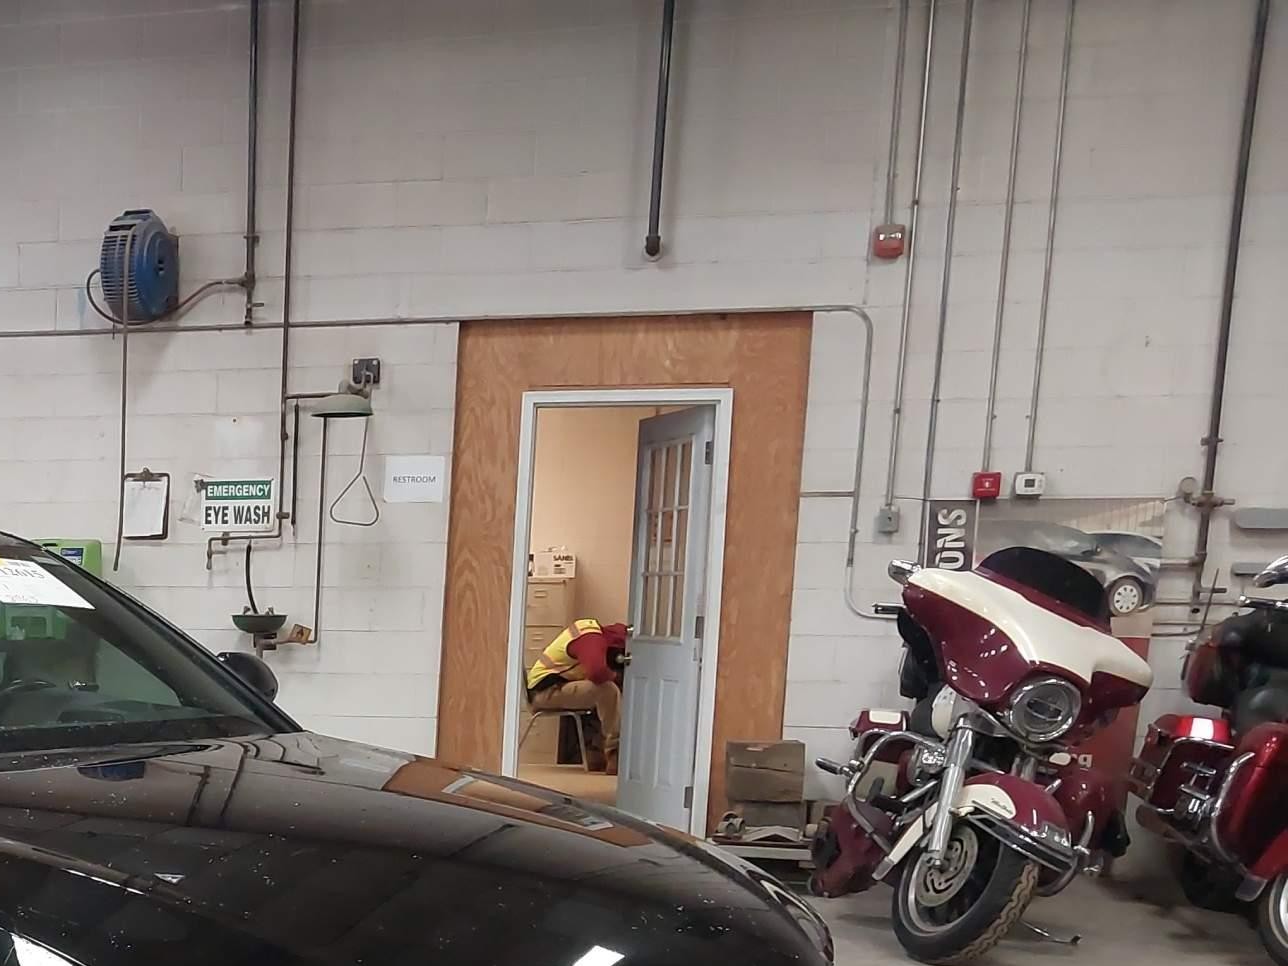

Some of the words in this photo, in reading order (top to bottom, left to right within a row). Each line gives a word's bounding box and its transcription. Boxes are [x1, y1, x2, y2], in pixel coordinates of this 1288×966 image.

[392, 475, 437, 484] RESTROOM
[207, 484, 271, 497] EMERGENCY
[205, 505, 229, 525] EYE
[233, 504, 271, 525] WASH
